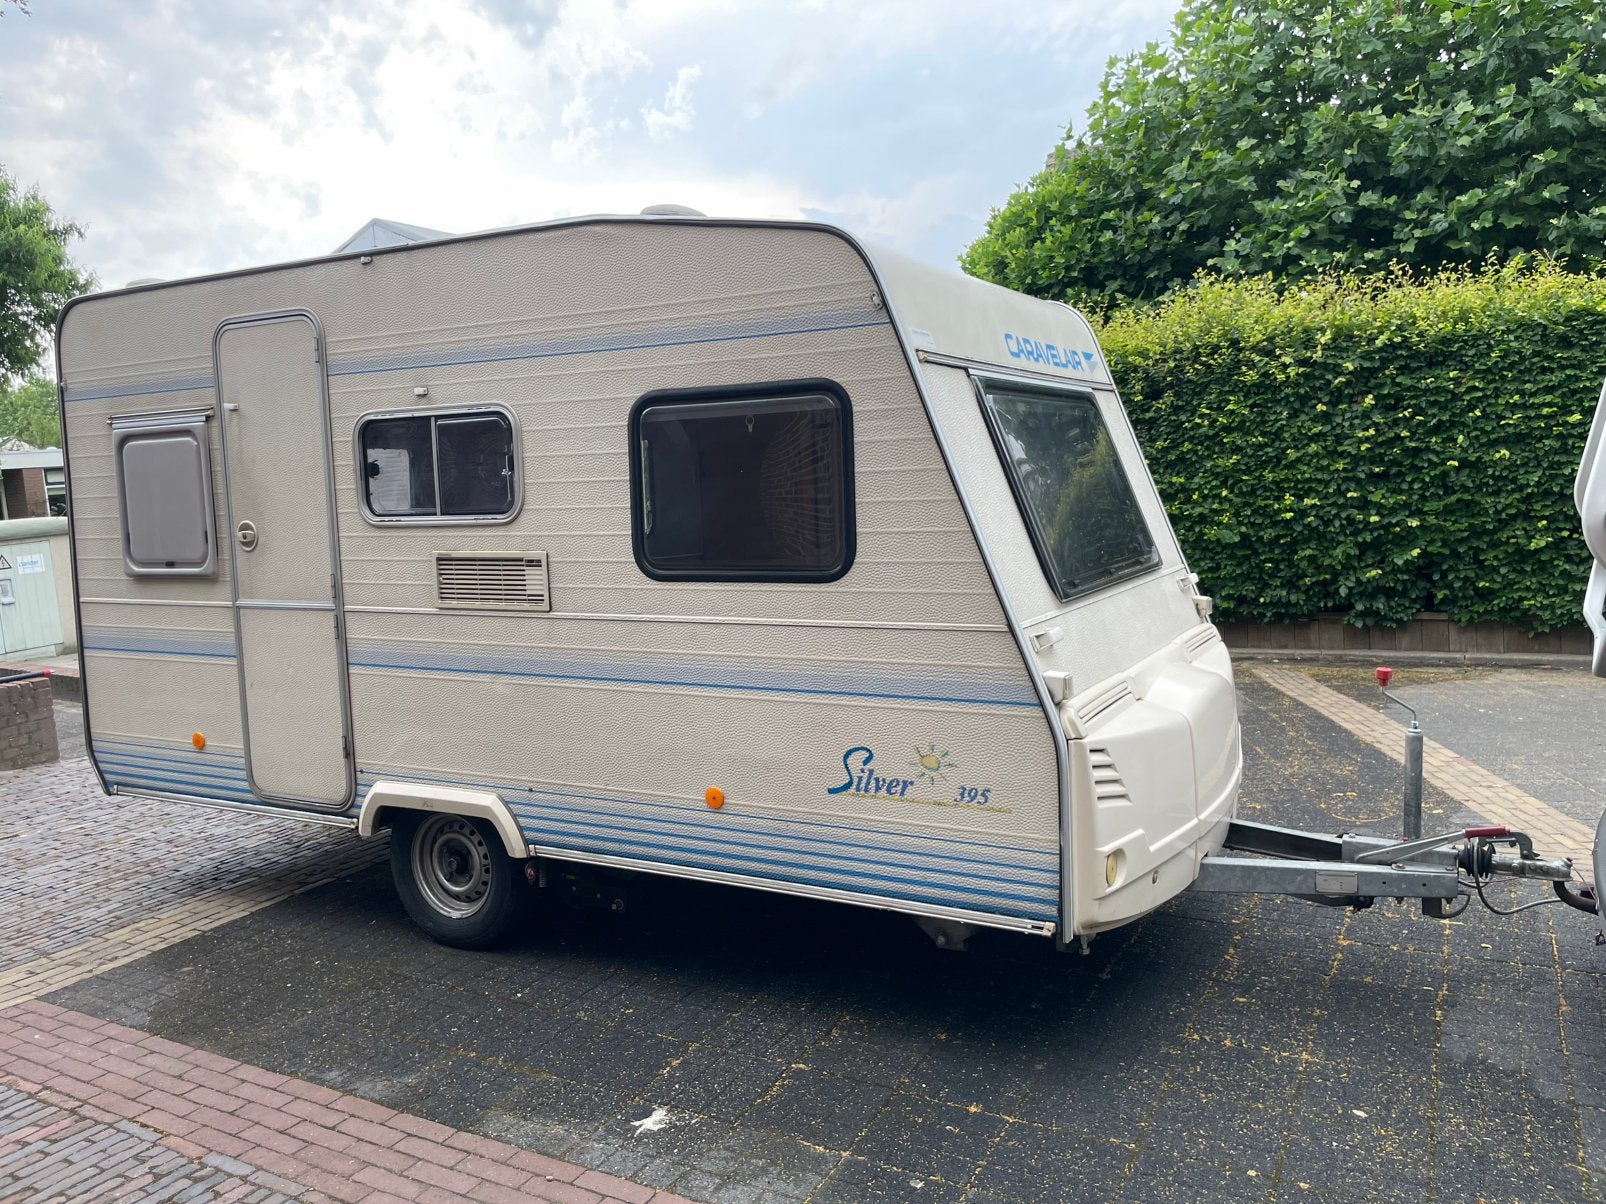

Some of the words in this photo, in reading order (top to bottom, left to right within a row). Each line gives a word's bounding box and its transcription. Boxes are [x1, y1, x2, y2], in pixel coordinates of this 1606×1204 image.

[1004, 333, 1084, 371] CARAVELAIR
[828, 746, 914, 797] Silver
[954, 785, 991, 805] 395
